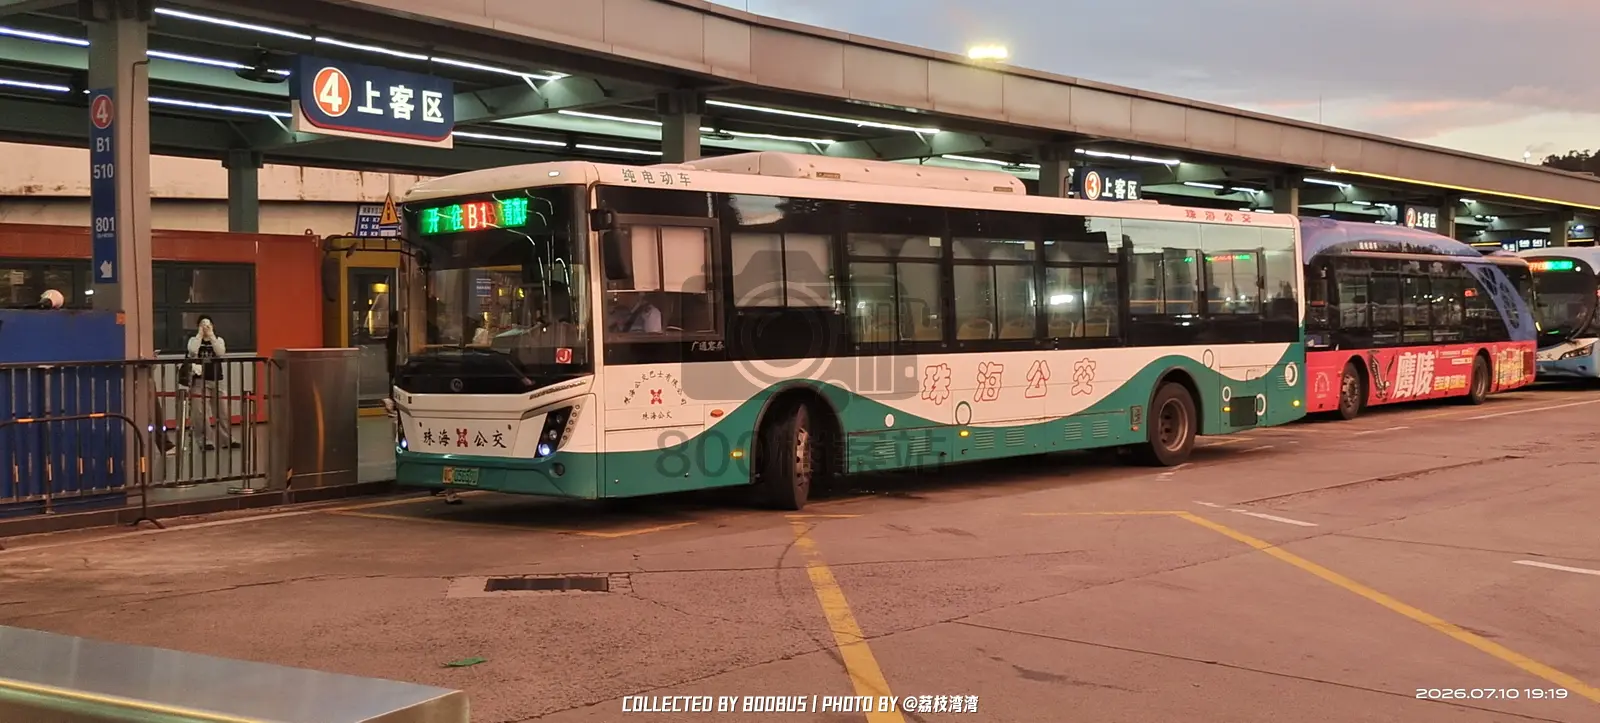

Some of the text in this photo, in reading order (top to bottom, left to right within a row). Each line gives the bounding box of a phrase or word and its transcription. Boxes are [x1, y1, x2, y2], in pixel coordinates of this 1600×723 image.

[318, 72, 445, 124] 4 上客区
[96, 99, 109, 123] 4
[96, 136, 111, 152] B1
[93, 163, 114, 180] 510
[621, 168, 692, 187] 纯电动车
[1087, 172, 1138, 200] 3 上客区
[95, 216, 115, 233] 801
[468, 202, 487, 229] B1
[1415, 211, 1437, 229] 上客区
[921, 357, 1097, 405] 珠海公交
[423, 427, 507, 449] 珠海 公交
